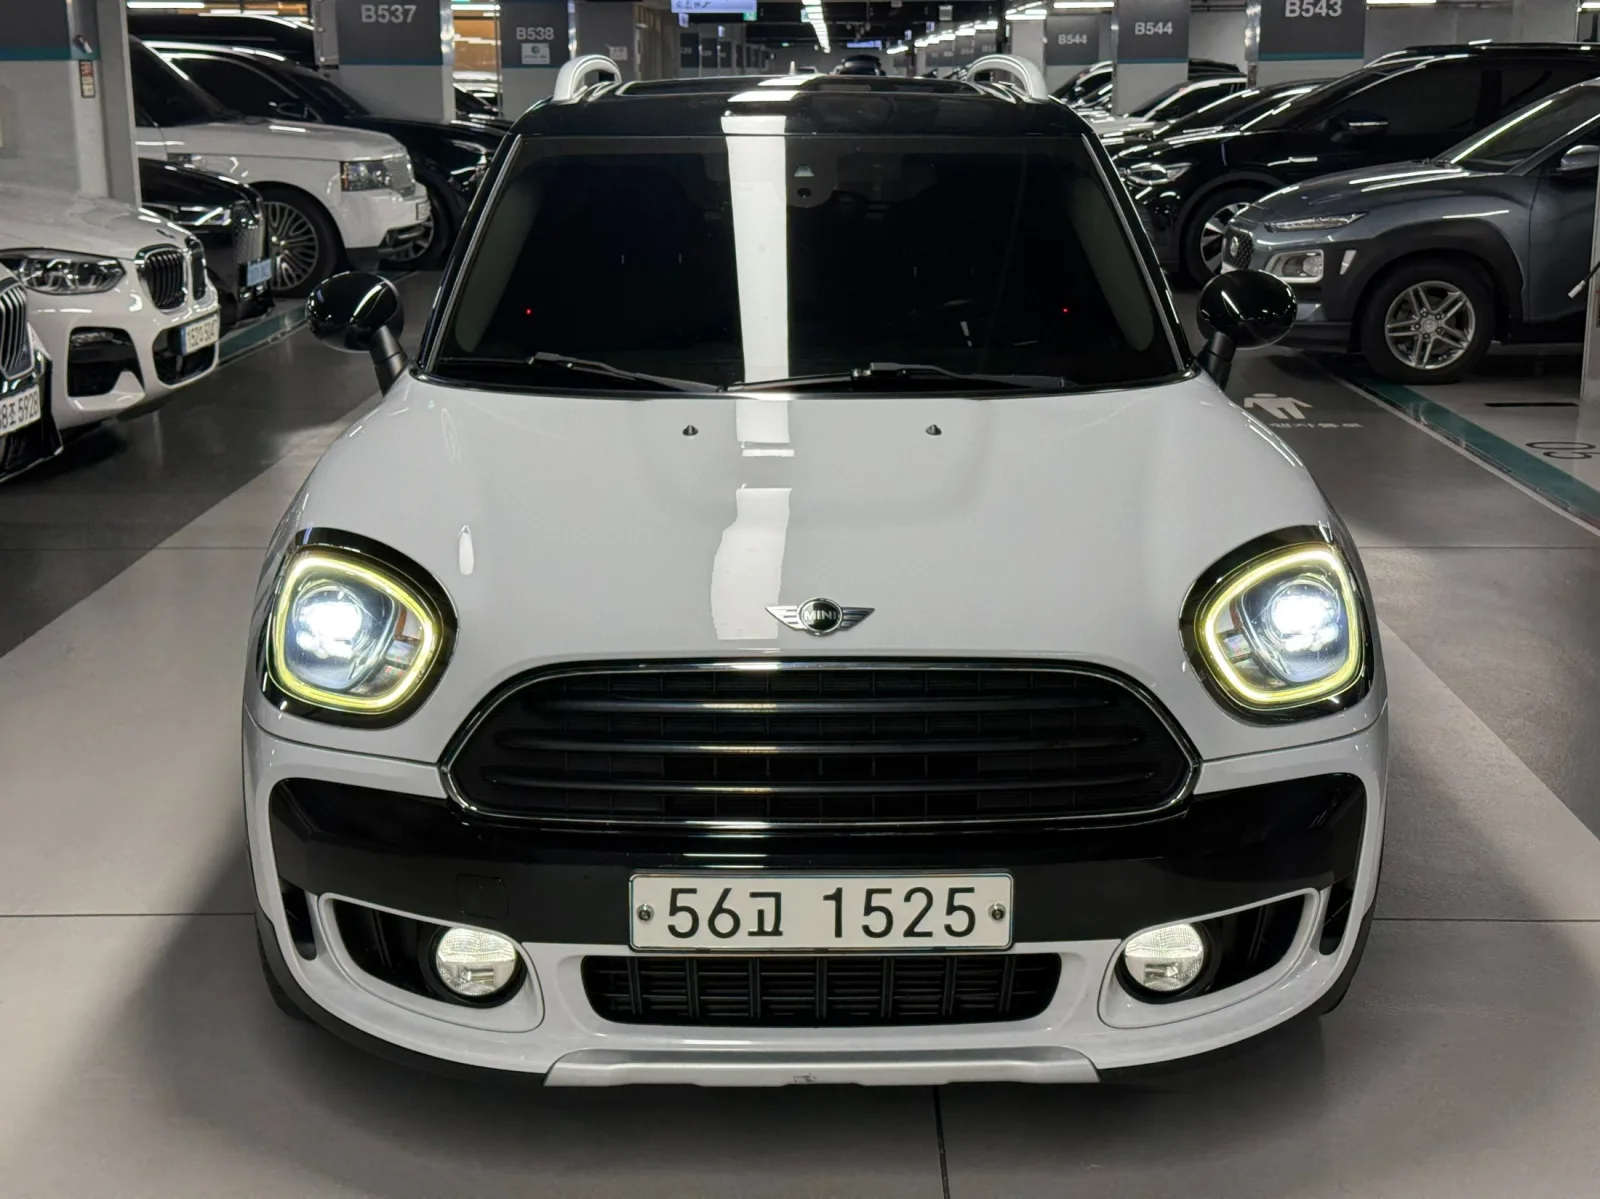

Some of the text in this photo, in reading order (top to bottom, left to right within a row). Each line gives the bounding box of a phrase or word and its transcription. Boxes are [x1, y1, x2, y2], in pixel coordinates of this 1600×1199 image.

[361, 4, 417, 24] B537
[1285, 0, 1343, 18] B543
[516, 27, 554, 41] B538
[1135, 22, 1173, 36] B544
[1059, 34, 1088, 46] B544
[803, 609, 837, 621] MINI
[667, 886, 976, 939] 56고 1525
